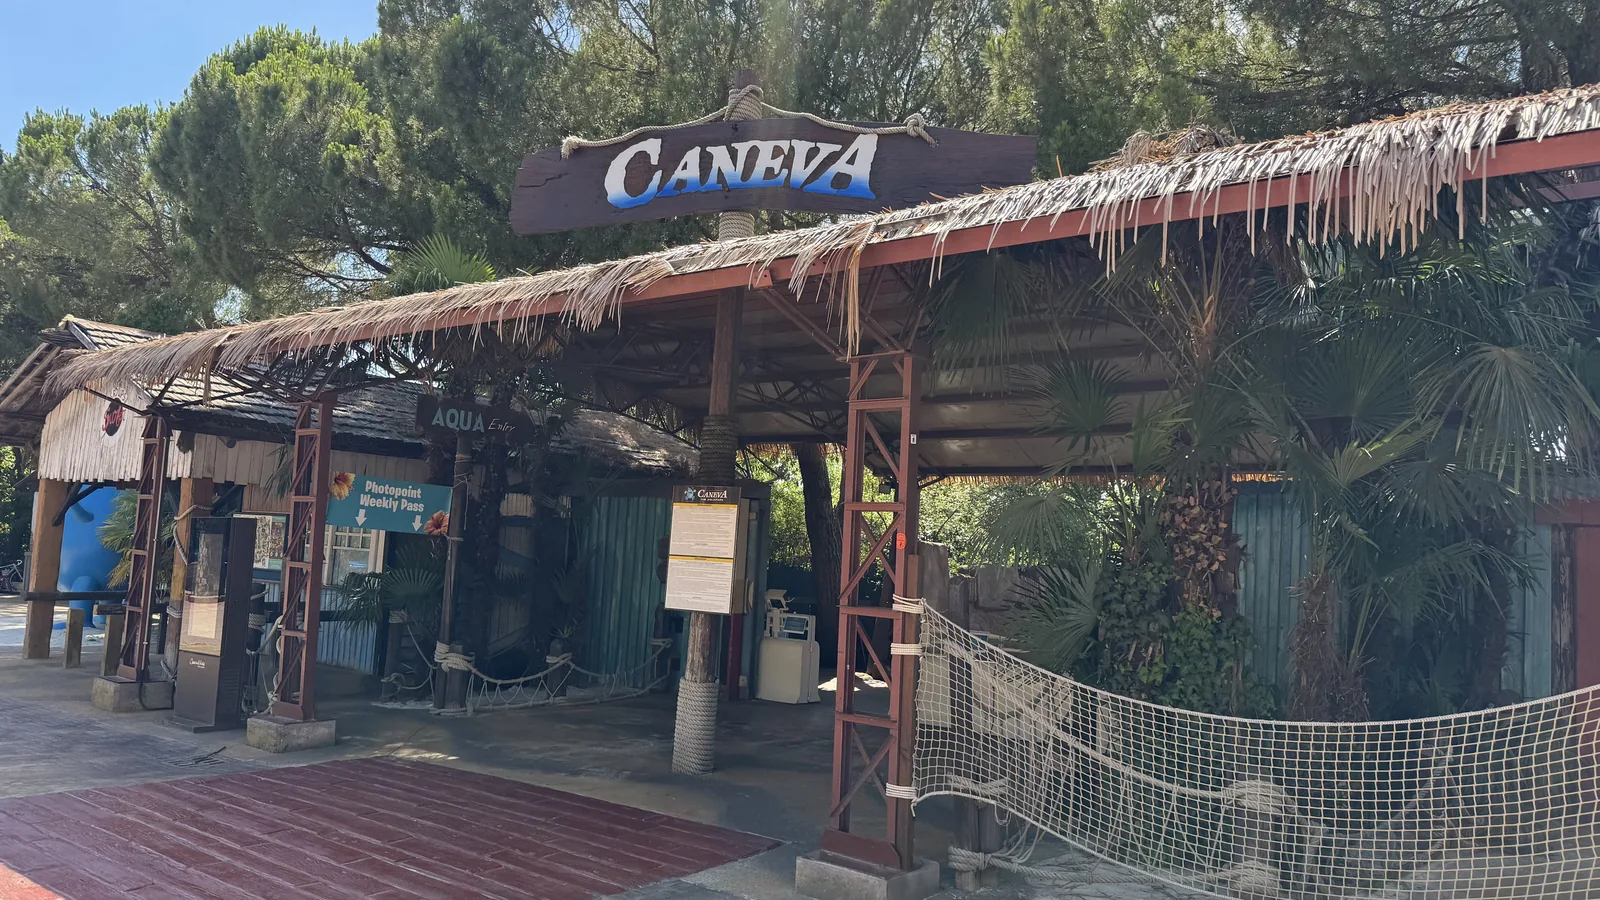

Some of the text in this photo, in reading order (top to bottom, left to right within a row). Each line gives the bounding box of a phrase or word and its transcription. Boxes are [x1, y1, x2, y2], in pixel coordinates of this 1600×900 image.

[604, 134, 878, 209] CANEVA
[431, 407, 485, 433] AQUA
[365, 480, 422, 499] Photopoint
[697, 490, 728, 499] CANEVA
[360, 494, 425, 513] Weekly Pass
